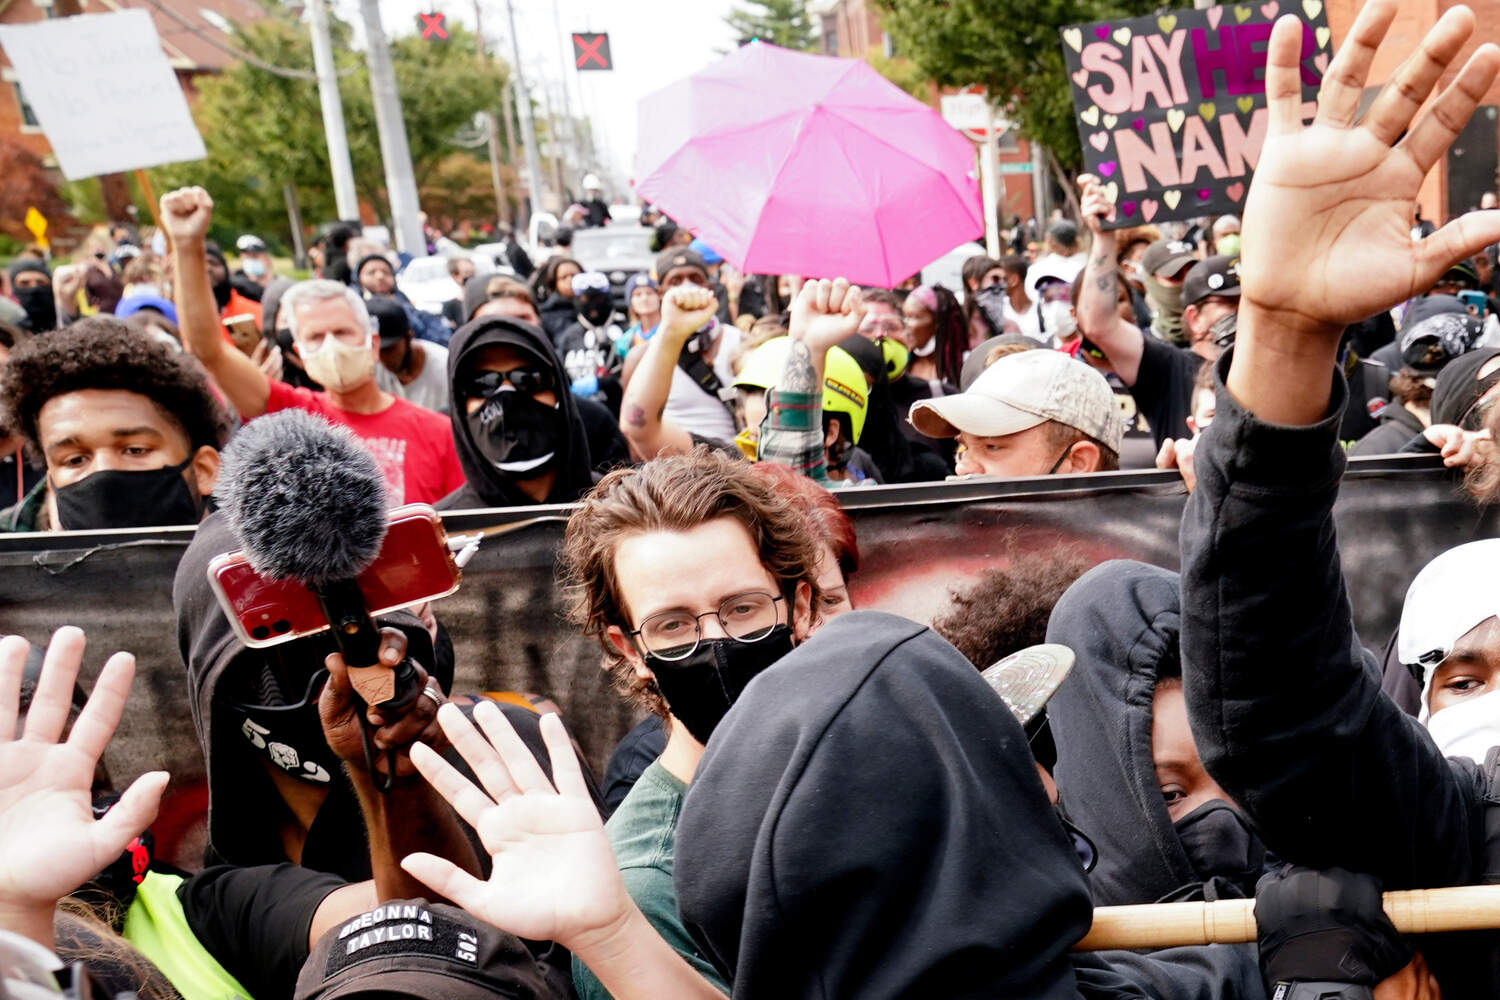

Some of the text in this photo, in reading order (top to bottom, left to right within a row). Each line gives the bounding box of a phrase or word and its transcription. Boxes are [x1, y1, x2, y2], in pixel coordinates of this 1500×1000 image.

[1081, 29, 1189, 114] SAY
[338, 904, 432, 940] BREONNA
[346, 923, 432, 953] TAYLOR
[457, 932, 478, 963] 502
